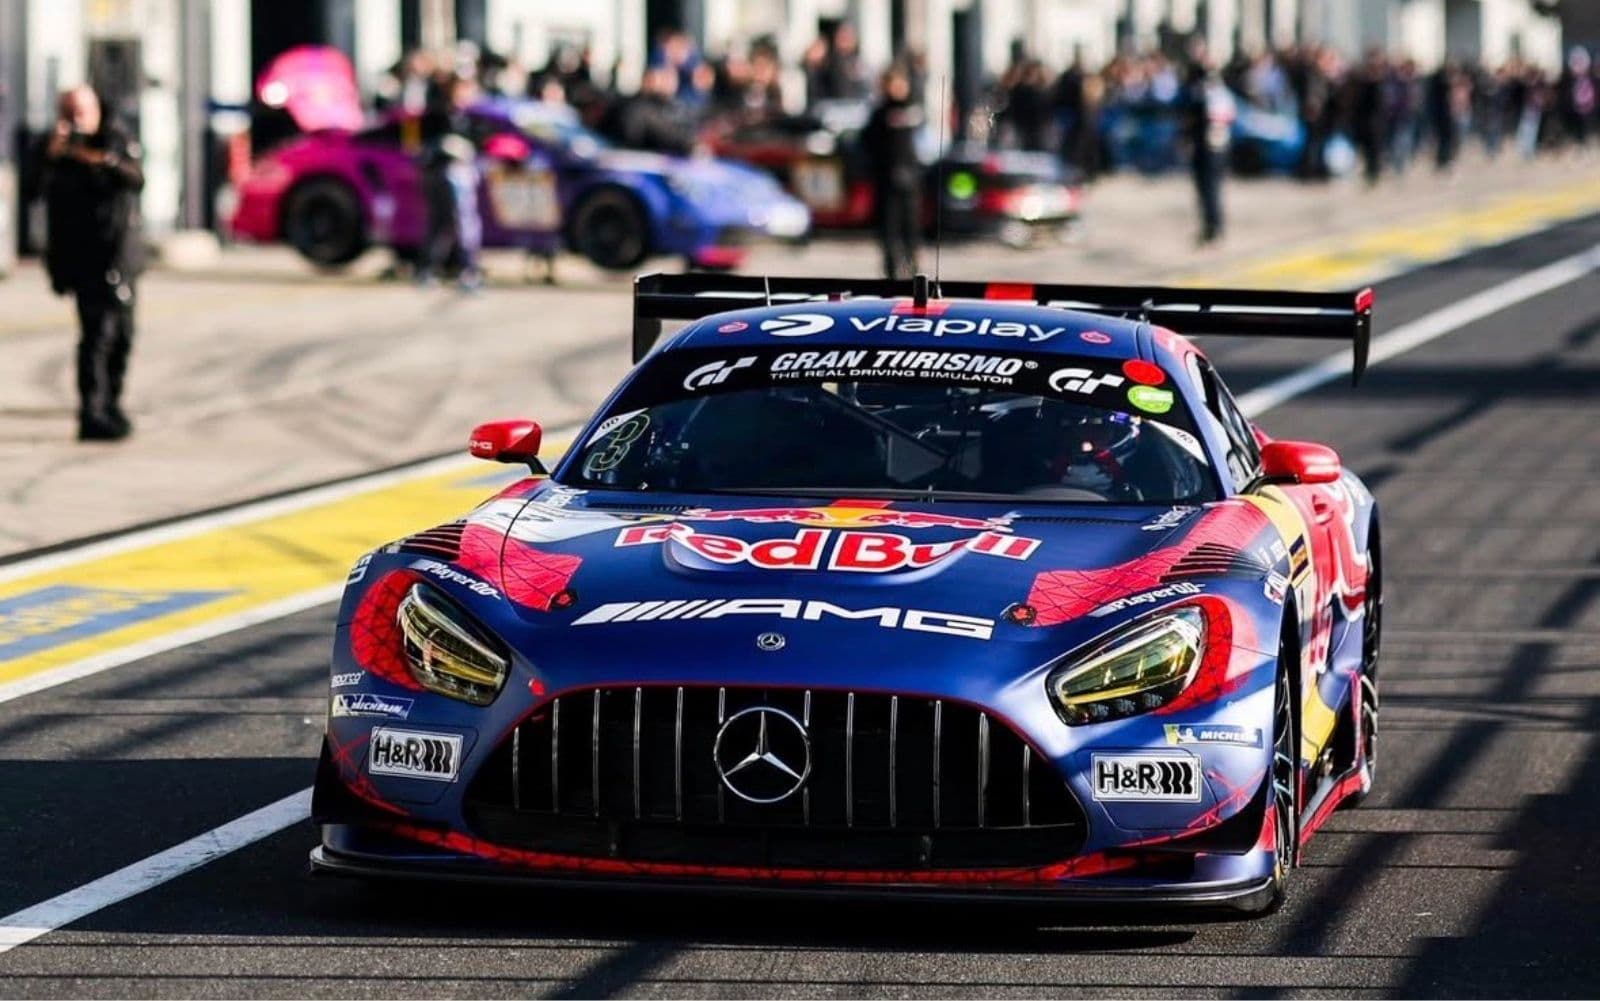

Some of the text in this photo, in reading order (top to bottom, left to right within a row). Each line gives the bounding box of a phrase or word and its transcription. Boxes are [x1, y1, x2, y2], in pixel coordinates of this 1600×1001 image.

[850, 315, 1065, 342] viaplay
[770, 350, 868, 372] GRAN
[770, 368, 1013, 385] THE REAL DRIVING SIMULATOR
[614, 521, 1043, 573] Red Bull
[373, 735, 422, 768] H&R
[1098, 760, 1157, 791] H&R
